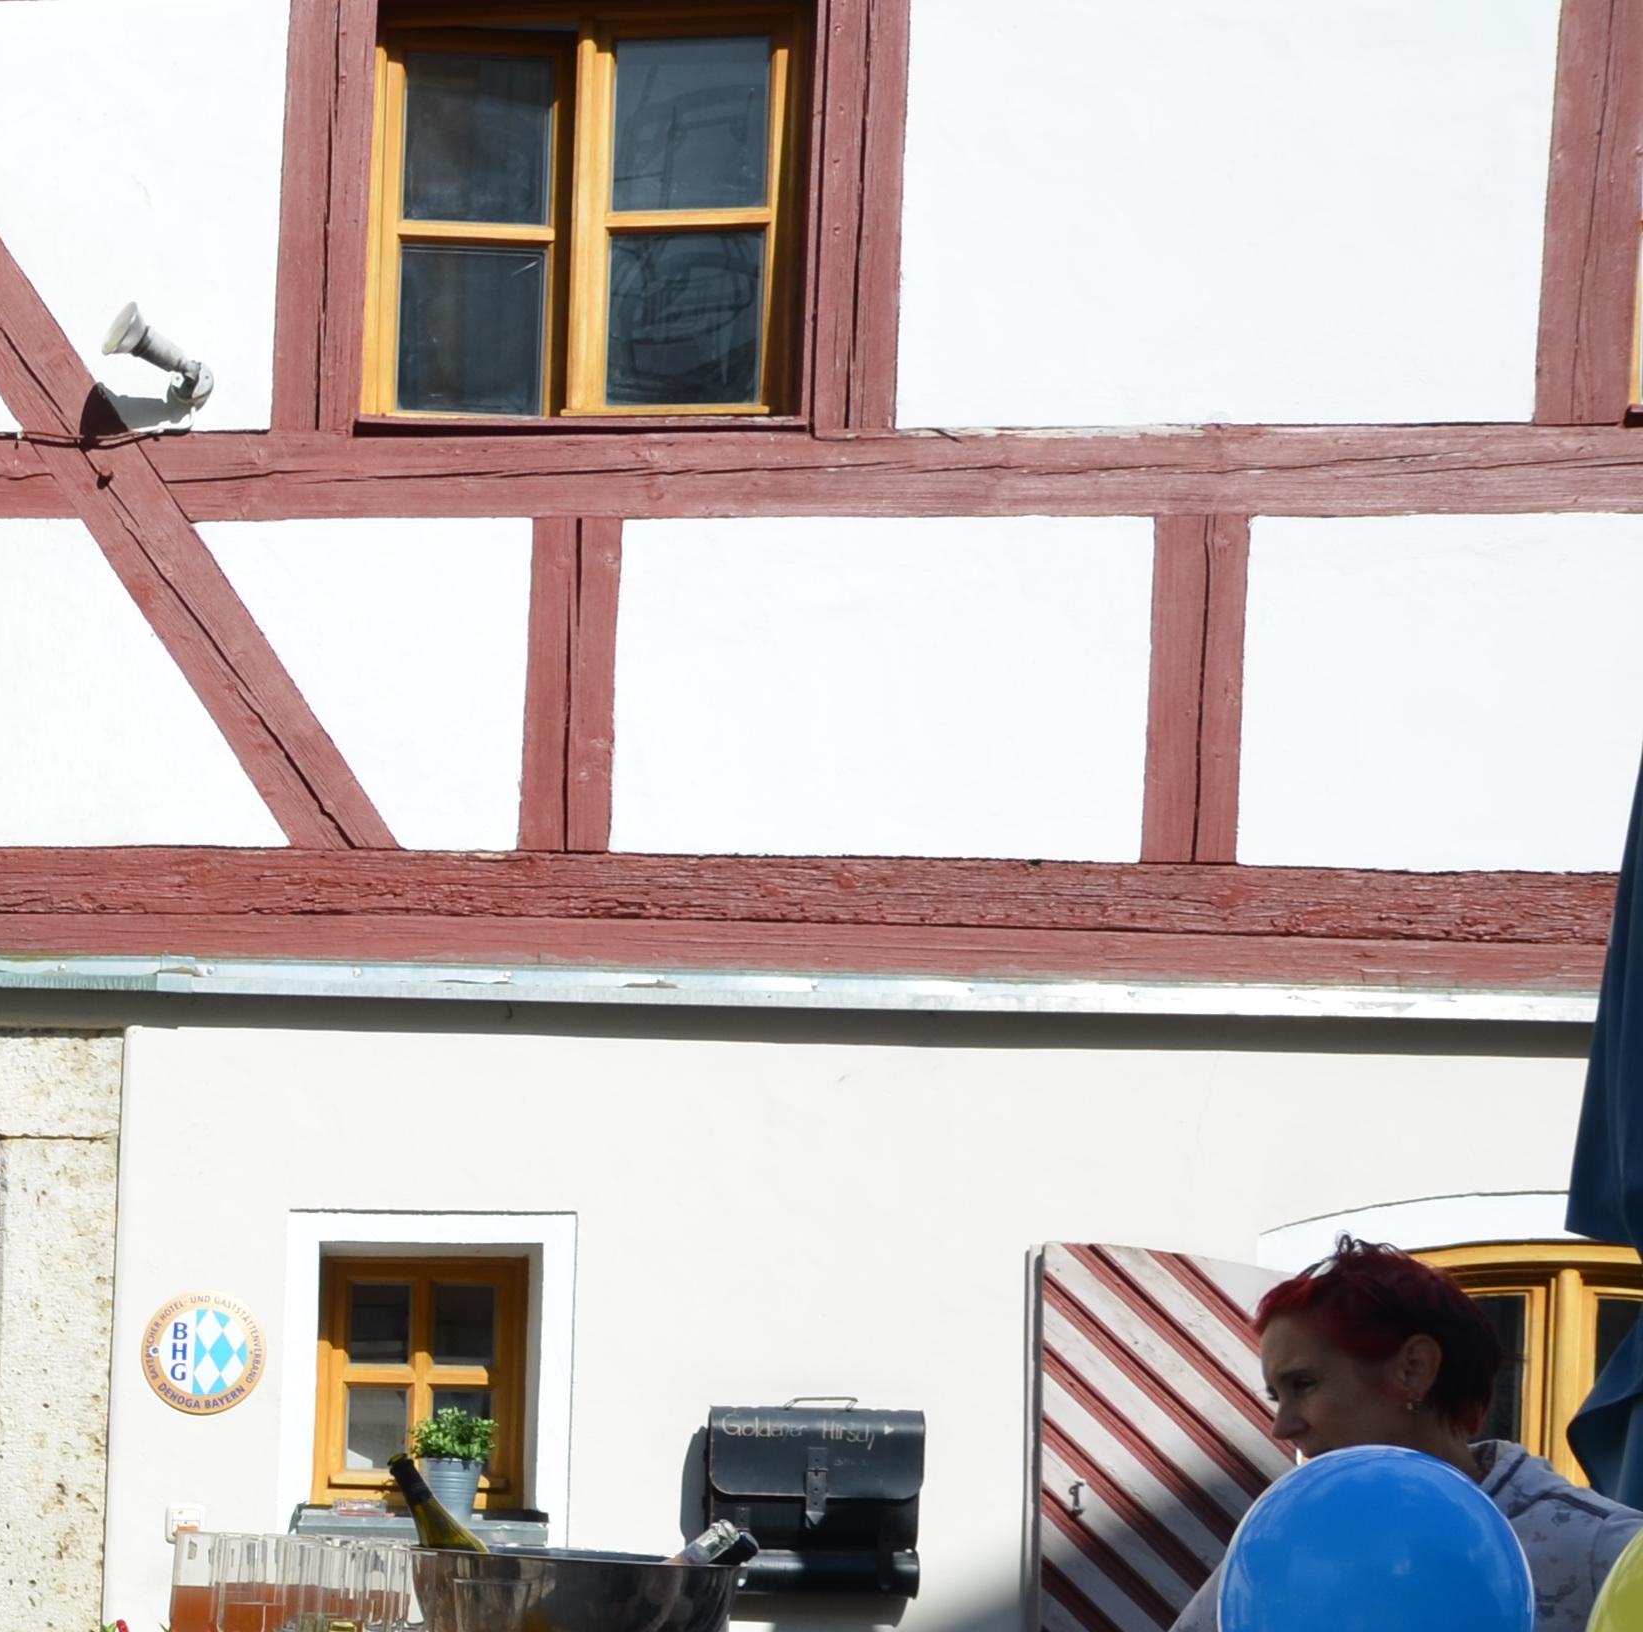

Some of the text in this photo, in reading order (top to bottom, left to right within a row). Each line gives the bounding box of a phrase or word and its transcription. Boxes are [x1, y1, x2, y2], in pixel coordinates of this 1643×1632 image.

[190, 1295, 211, 1304] UND
[158, 1382, 246, 1409] DEHOGA BAYERN
[721, 1413, 875, 1451] Goldener Hirsch
